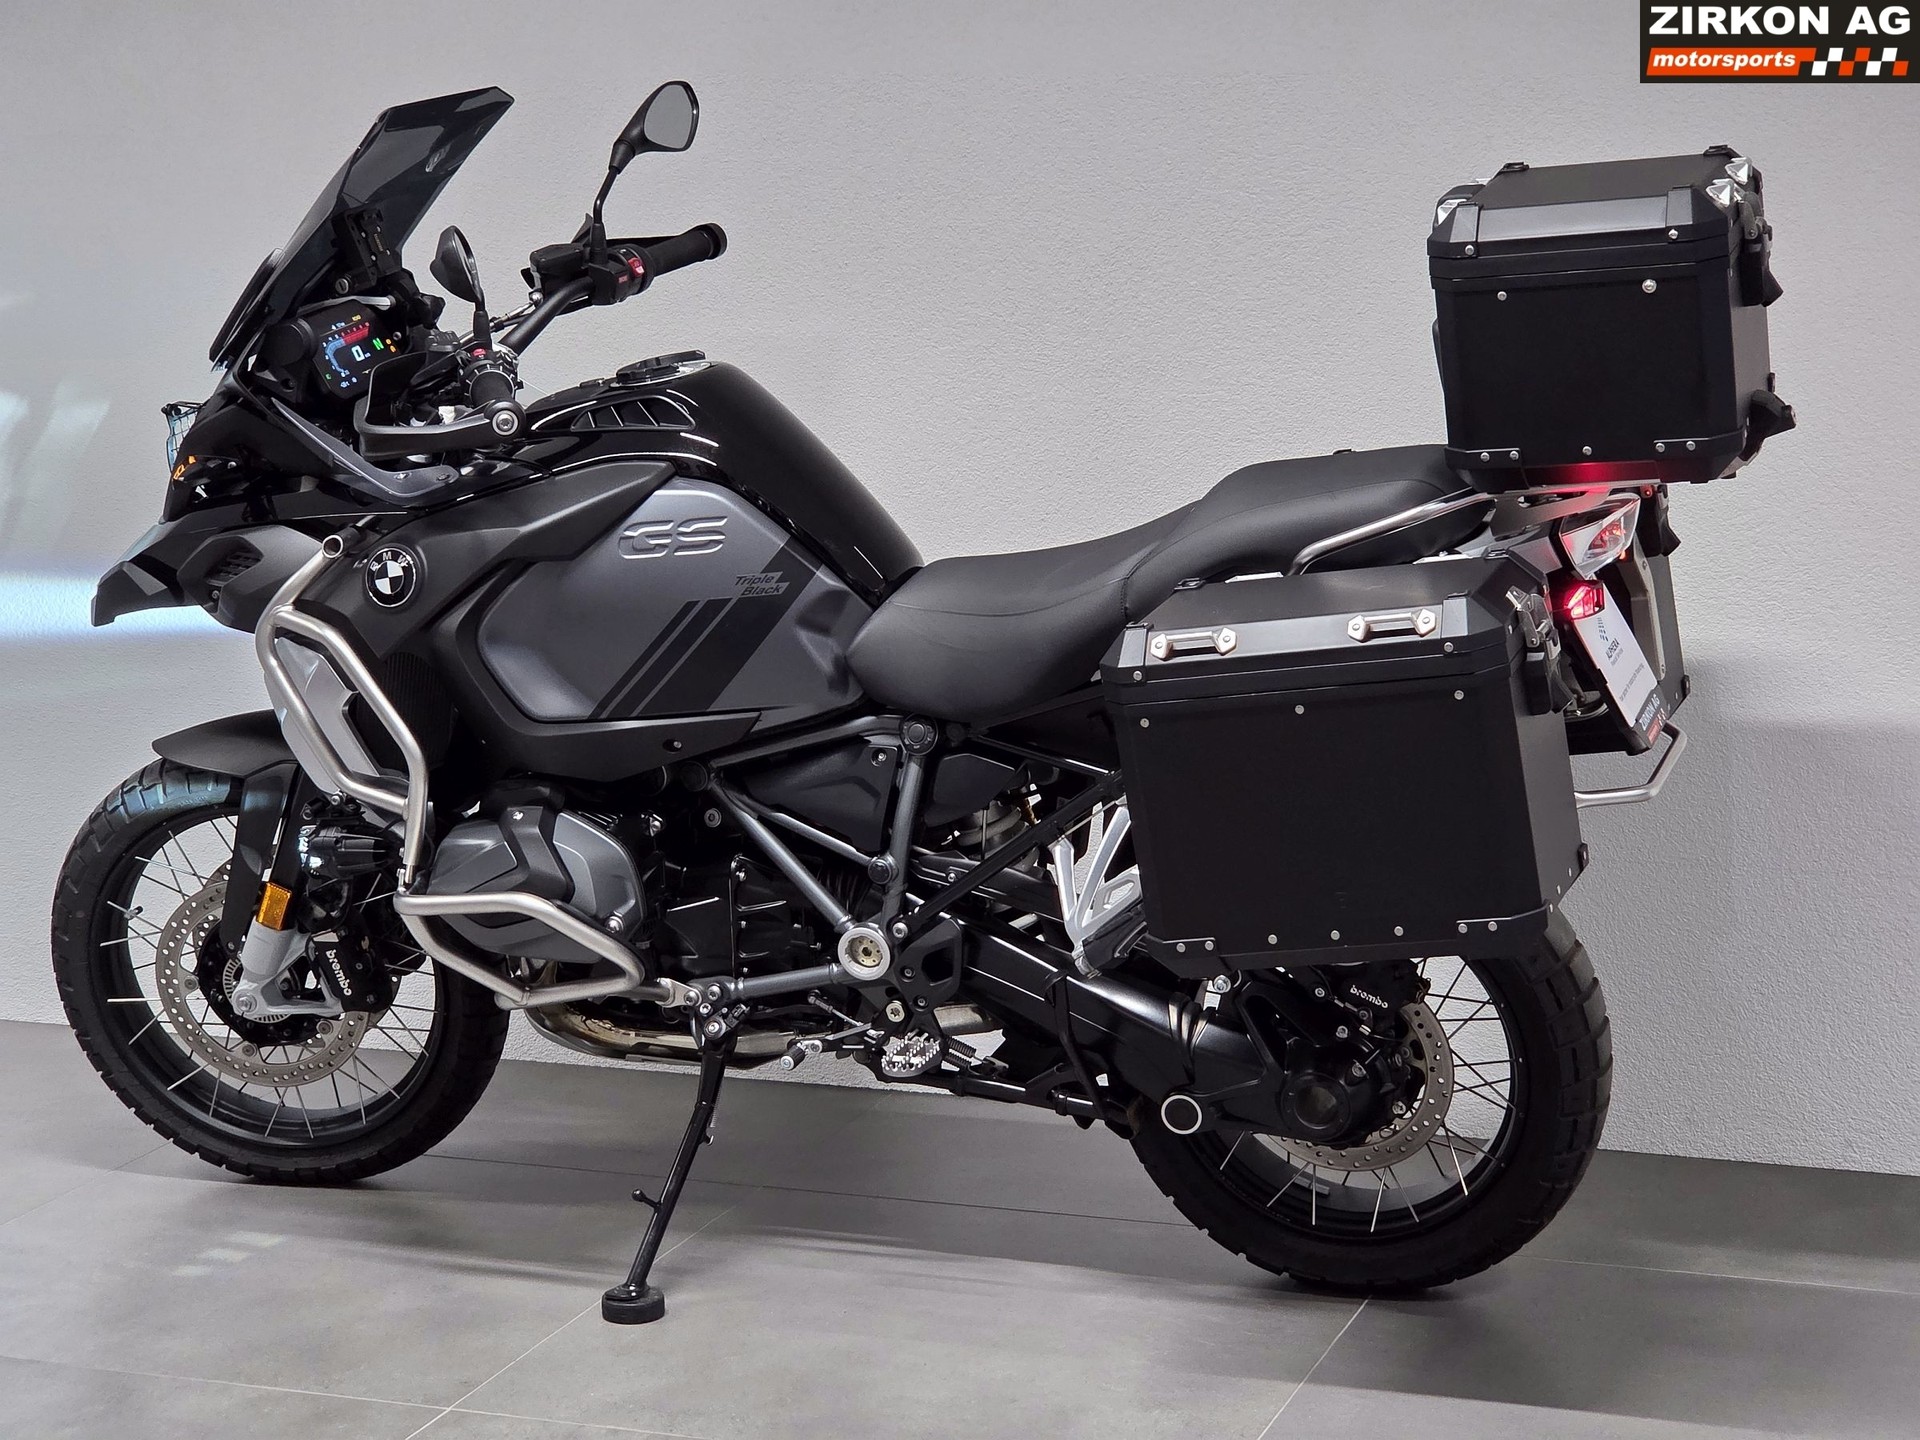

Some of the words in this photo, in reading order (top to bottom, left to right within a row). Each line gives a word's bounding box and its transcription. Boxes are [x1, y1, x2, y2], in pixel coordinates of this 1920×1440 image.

[372, 337, 385, 351] N
[618, 515, 728, 560] GS
[369, 551, 409, 572] BMW
[734, 573, 775, 587] Triple
[741, 584, 784, 597] Black
[325, 949, 353, 996] brembo
[1350, 984, 1389, 1009] brembo
